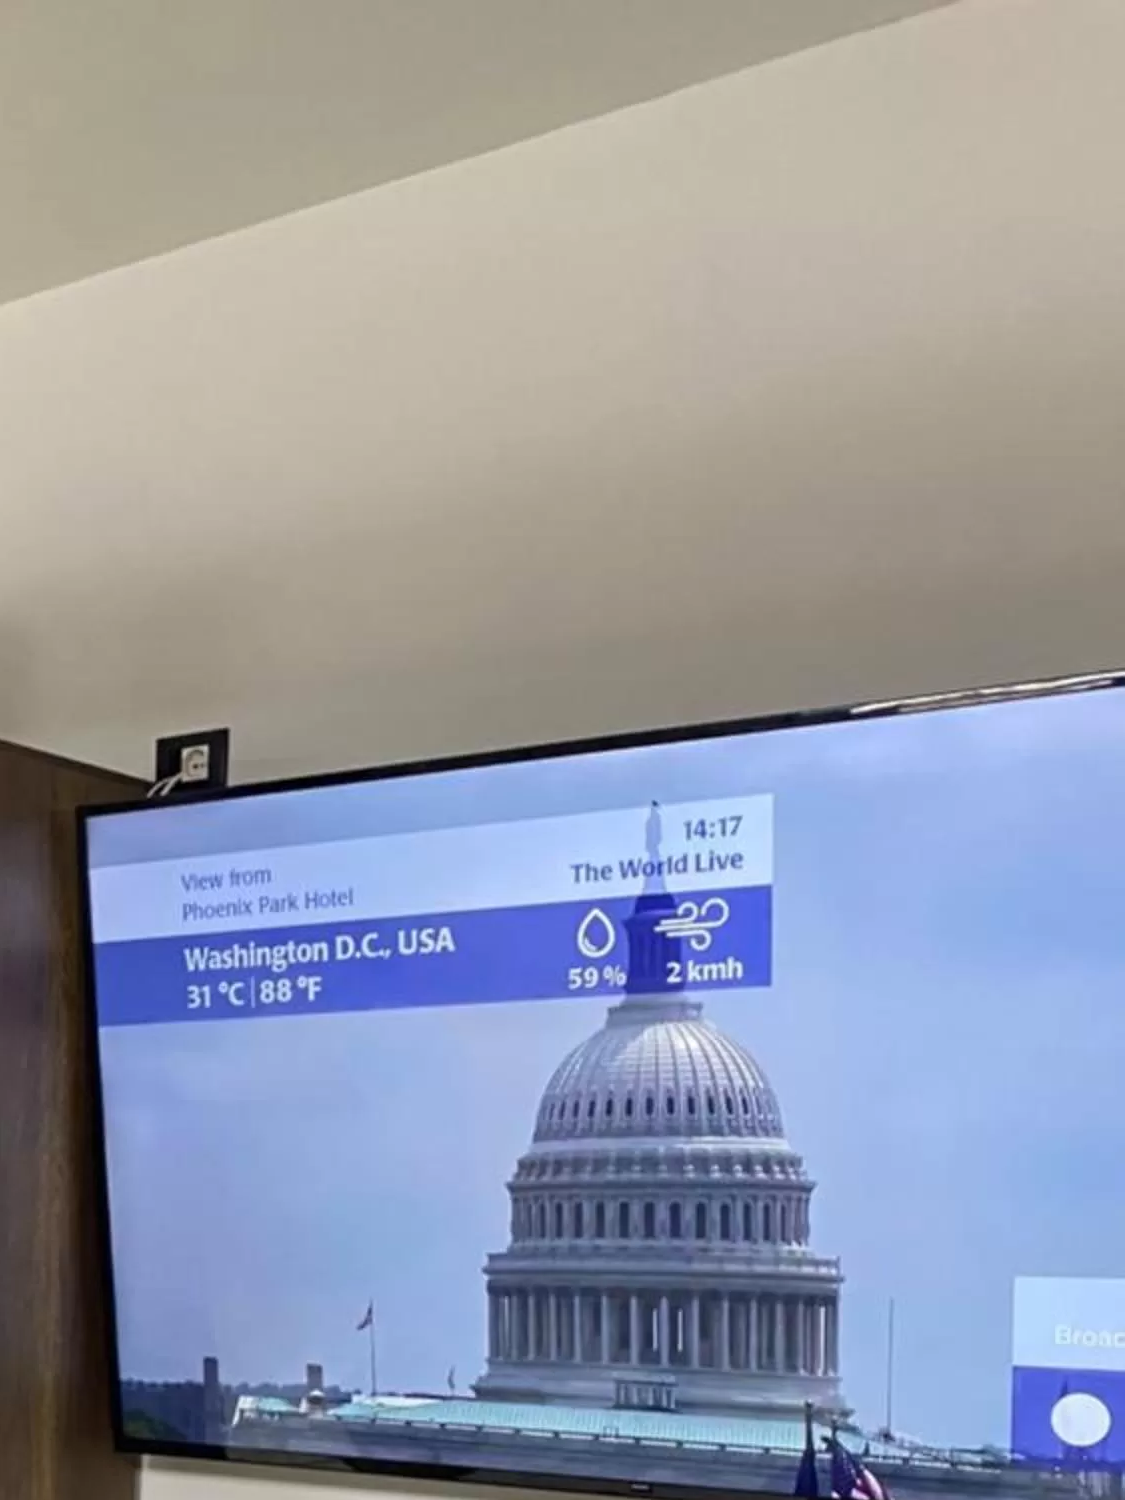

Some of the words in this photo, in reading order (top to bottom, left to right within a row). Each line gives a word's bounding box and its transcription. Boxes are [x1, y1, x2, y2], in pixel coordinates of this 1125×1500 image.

[683, 815, 743, 841] 14:17
[180, 871, 224, 892] View
[229, 867, 272, 887] from
[570, 863, 614, 884] The
[619, 853, 688, 880] World
[695, 850, 744, 873] Live
[182, 897, 253, 922] Phoenix
[259, 893, 300, 915] Park
[305, 887, 354, 909] Hotel
[183, 938, 329, 973] Washington
[334, 932, 392, 961] D.C.,
[398, 926, 456, 956] USA
[666, 961, 683, 984] 2
[686, 956, 744, 982] kmh
